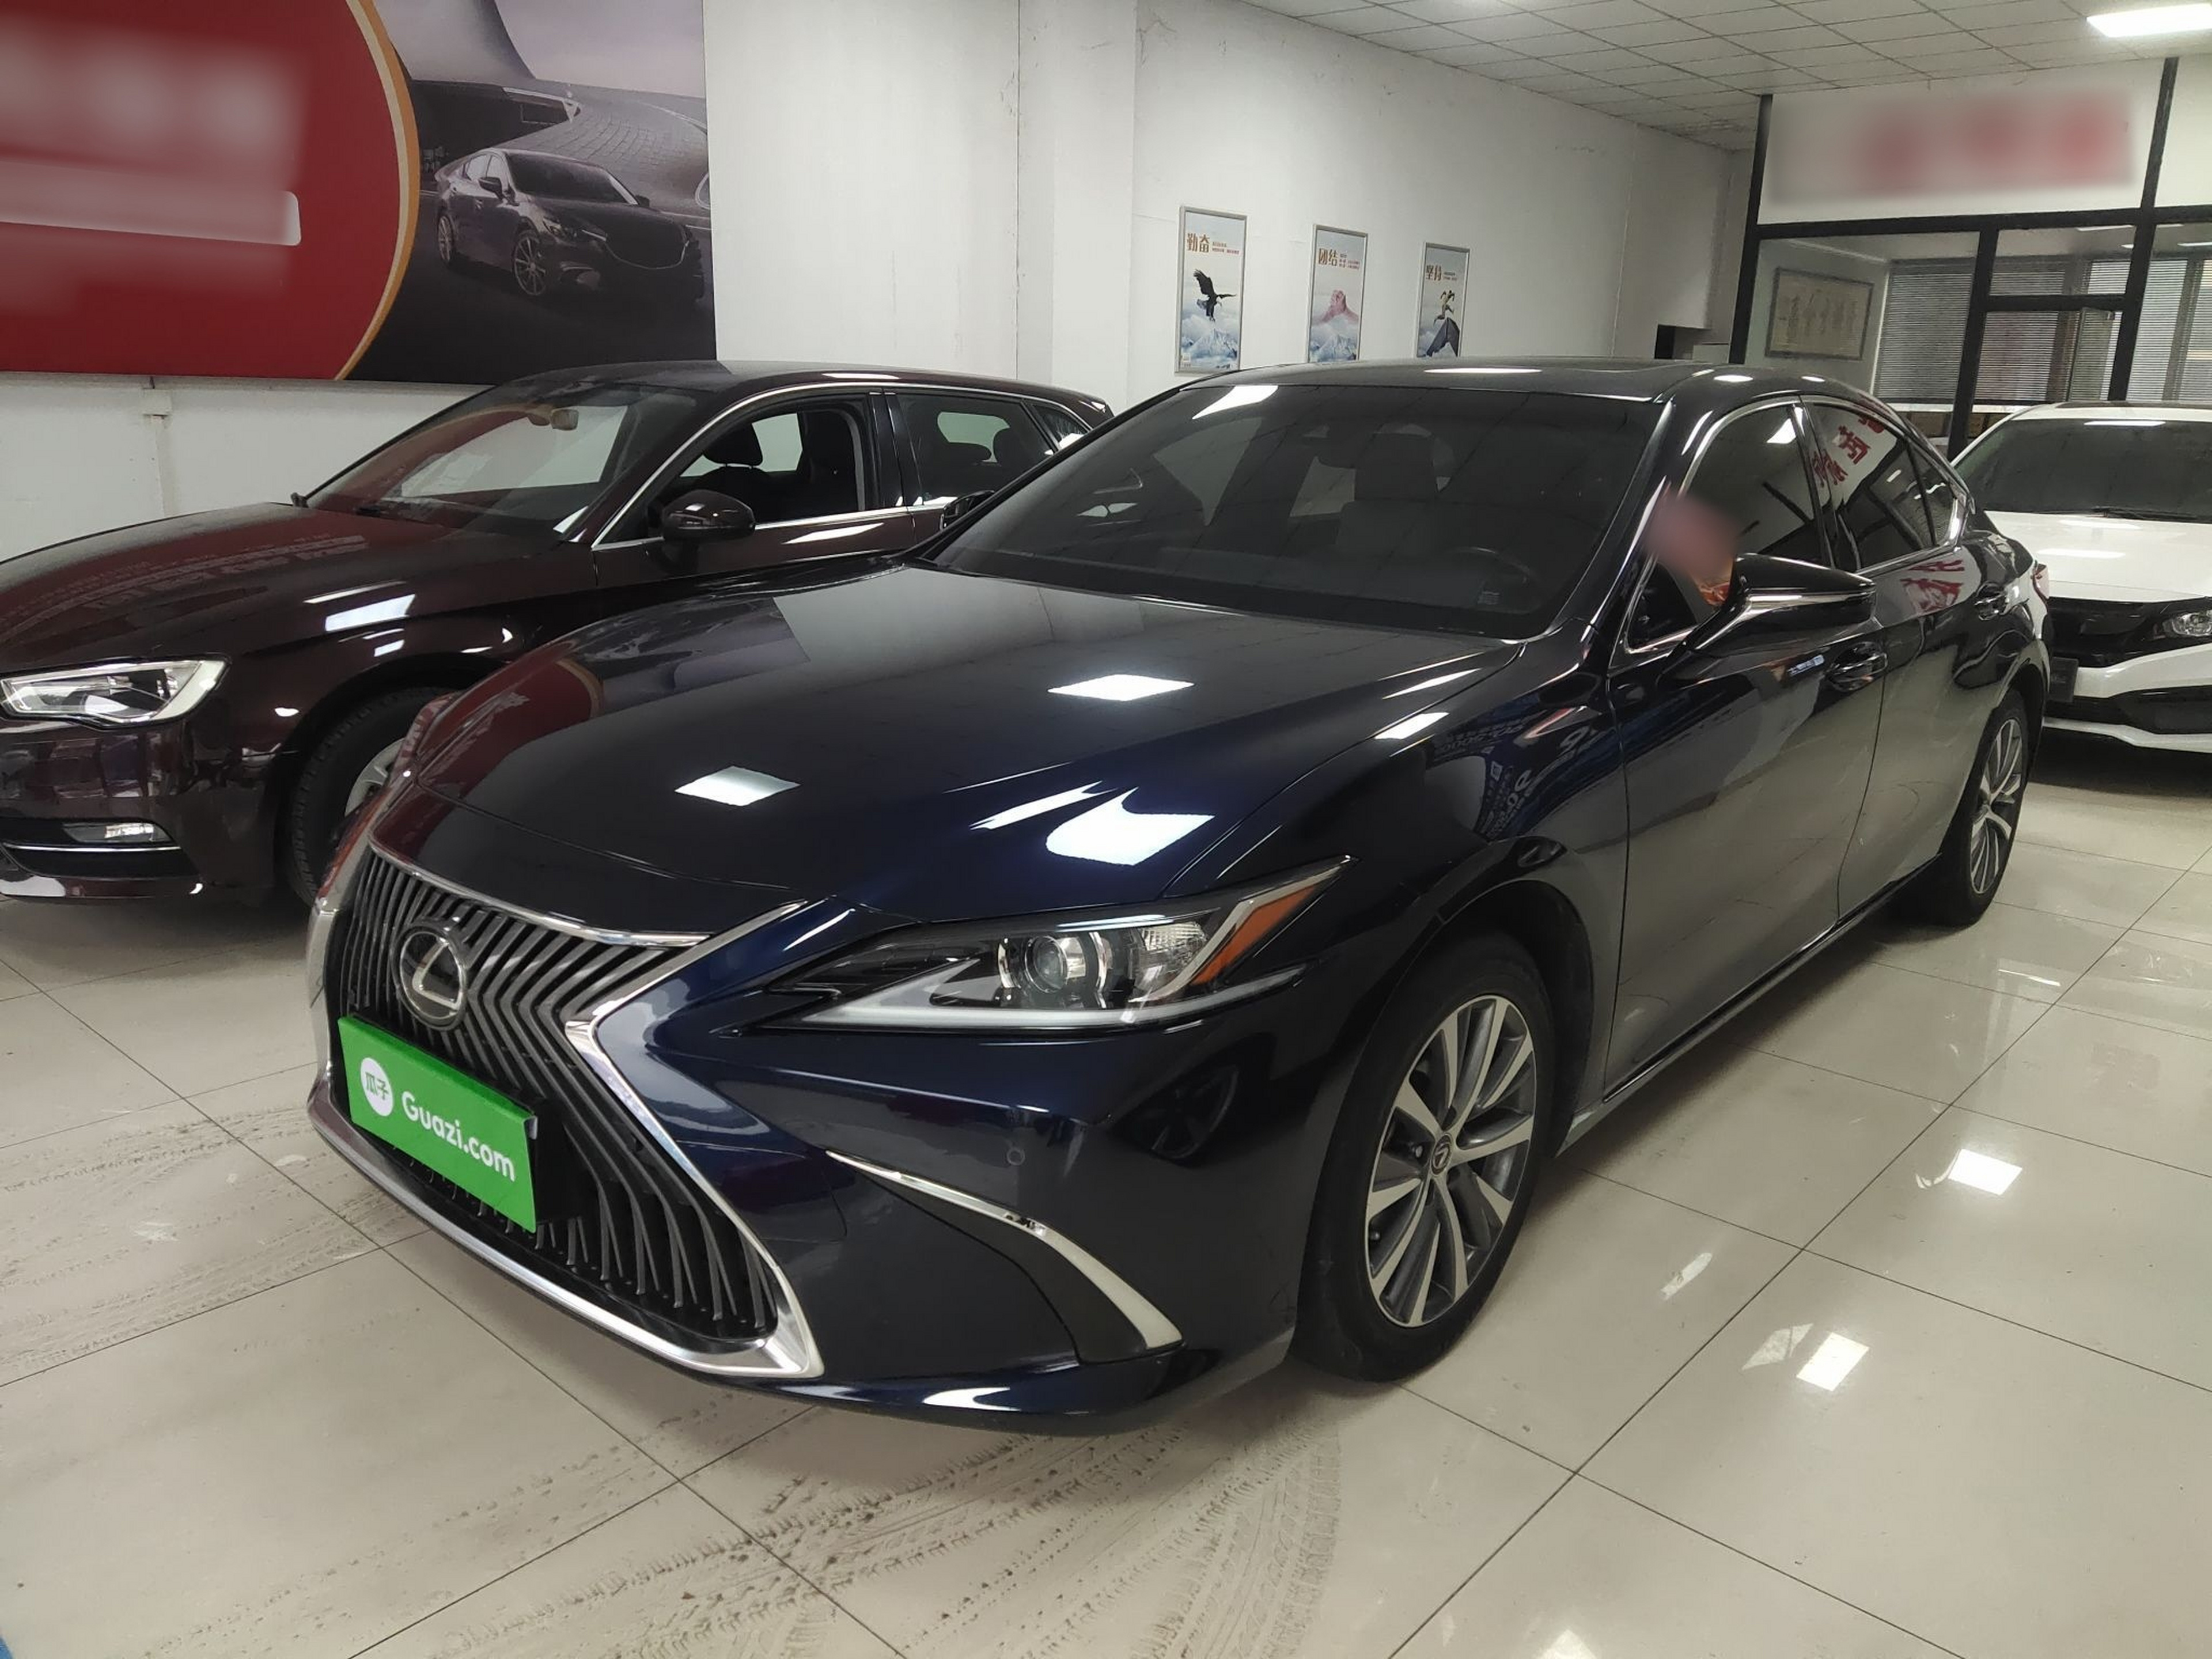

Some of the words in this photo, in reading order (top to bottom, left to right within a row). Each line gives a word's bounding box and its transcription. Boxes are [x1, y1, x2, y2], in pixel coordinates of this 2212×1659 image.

[1187, 233, 1210, 253] 勤奋
[1319, 248, 1338, 266] 团结
[365, 1071, 389, 1101] 瓜子
[402, 1091, 515, 1182] Guazi.com
